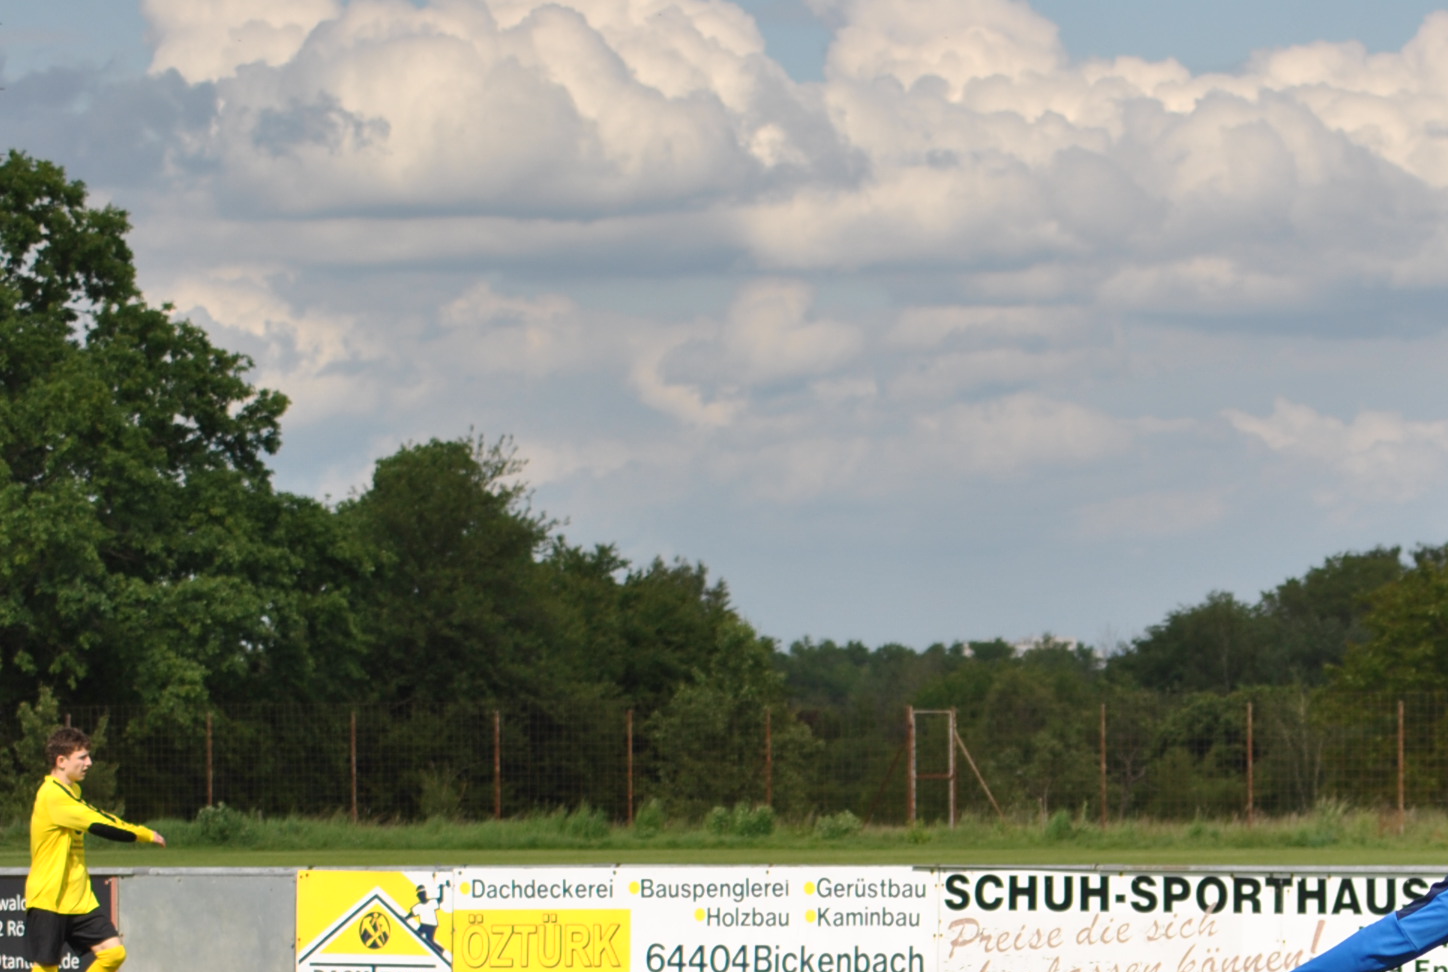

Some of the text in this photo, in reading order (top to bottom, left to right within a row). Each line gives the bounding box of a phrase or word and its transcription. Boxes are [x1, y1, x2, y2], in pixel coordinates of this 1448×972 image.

[471, 877, 926, 902] Dachdeckerei Bauspenglerei Gerüstbau
[706, 907, 920, 927] Holzbau Kaminbau
[948, 902, 1219, 958] Preise die sich
[461, 913, 622, 968] ÖZTÜRK
